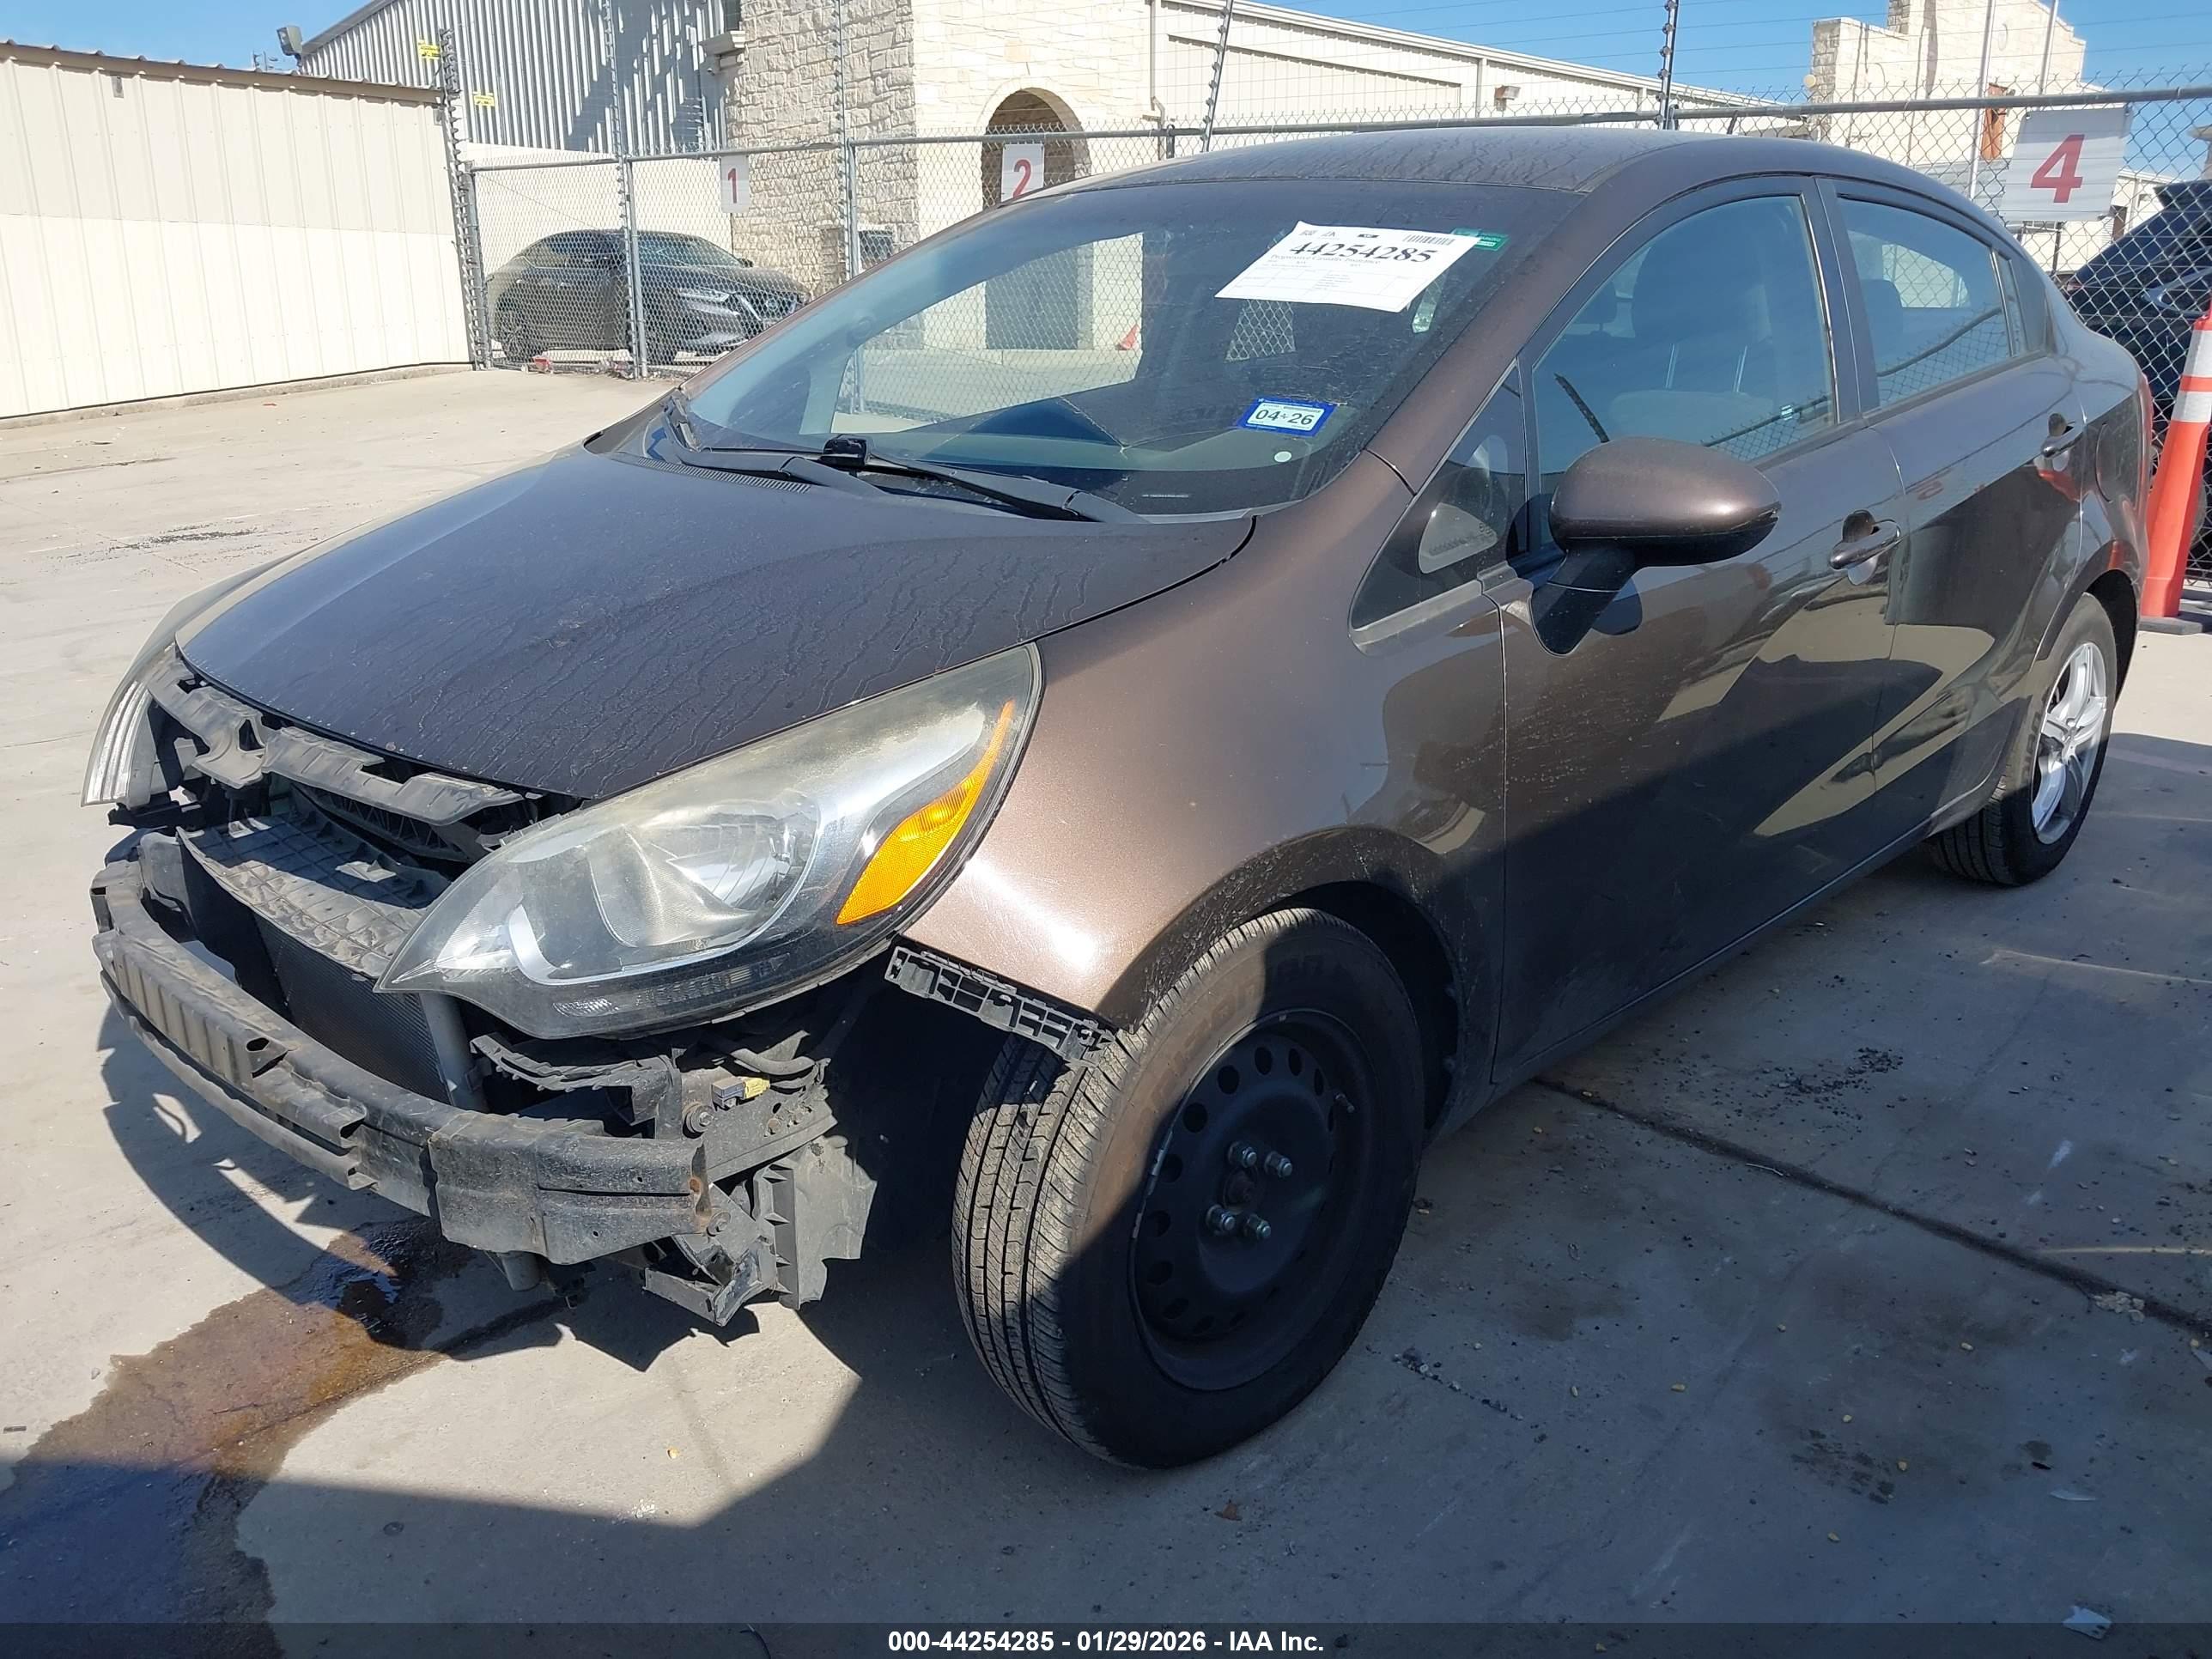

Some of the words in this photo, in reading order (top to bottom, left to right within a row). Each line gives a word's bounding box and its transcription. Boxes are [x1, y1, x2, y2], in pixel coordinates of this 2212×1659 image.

[727, 167, 738, 204] 1
[1012, 159, 1031, 199] 2
[2030, 134, 2085, 204] 4
[1290, 241, 1437, 263] 44254285
[1255, 410, 1281, 422] 04
[1288, 413, 1315, 426] 26
